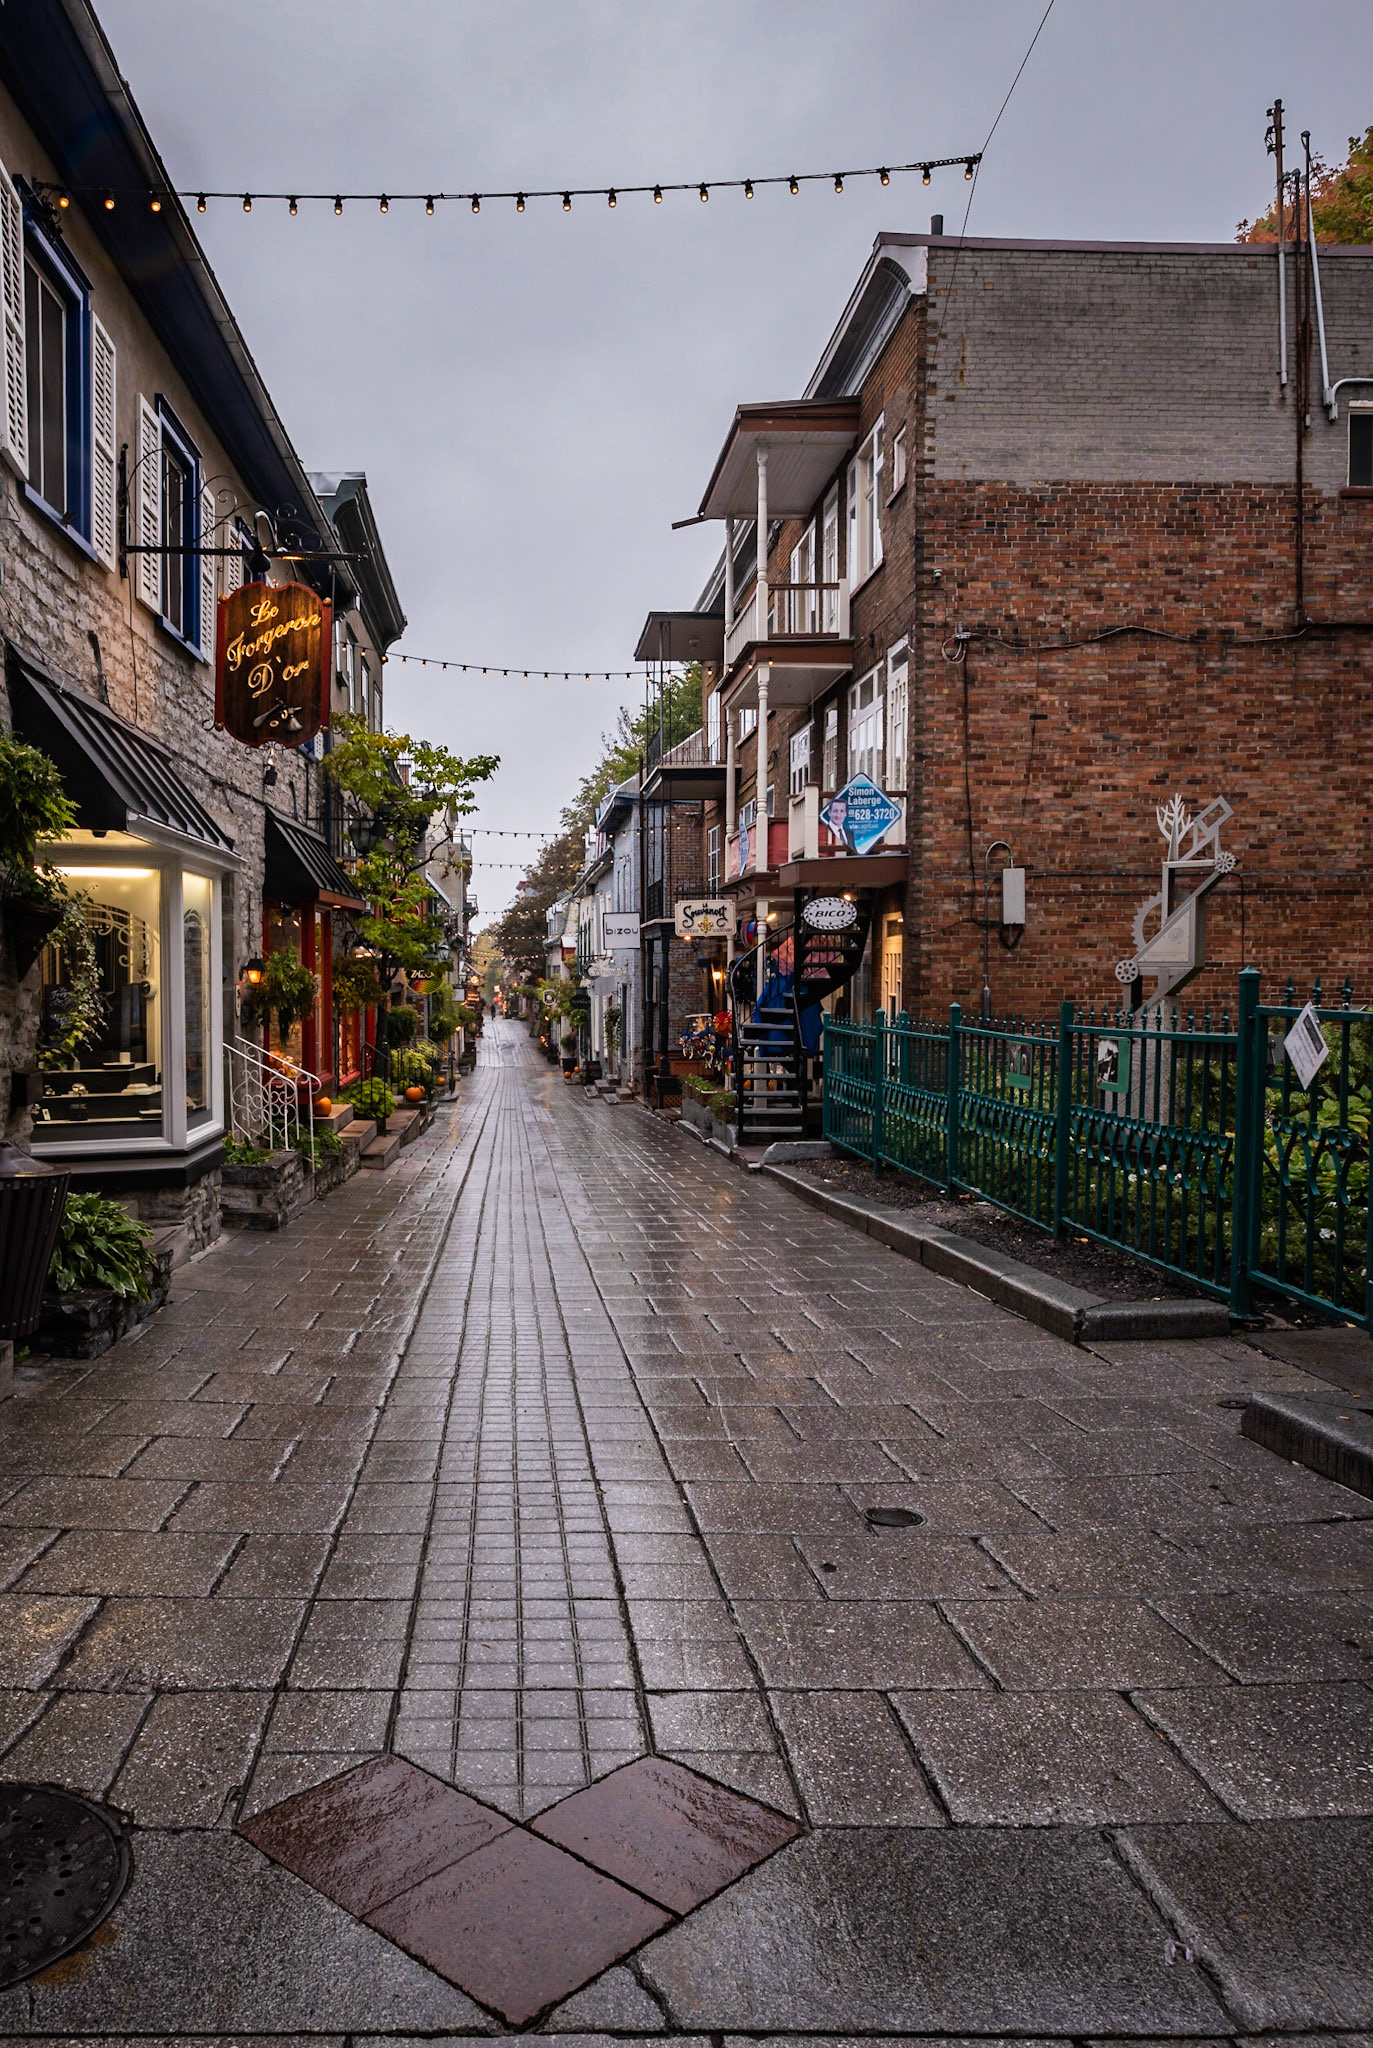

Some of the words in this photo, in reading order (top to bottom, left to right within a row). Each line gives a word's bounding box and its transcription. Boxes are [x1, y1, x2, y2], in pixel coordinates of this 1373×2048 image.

[250, 600, 279, 627] Le
[227, 613, 321, 671] Forgeron
[848, 787, 874, 796] Simon
[847, 796, 881, 806] Laberge
[855, 808, 895, 820] 628-3720
[605, 921, 638, 935] bizou
